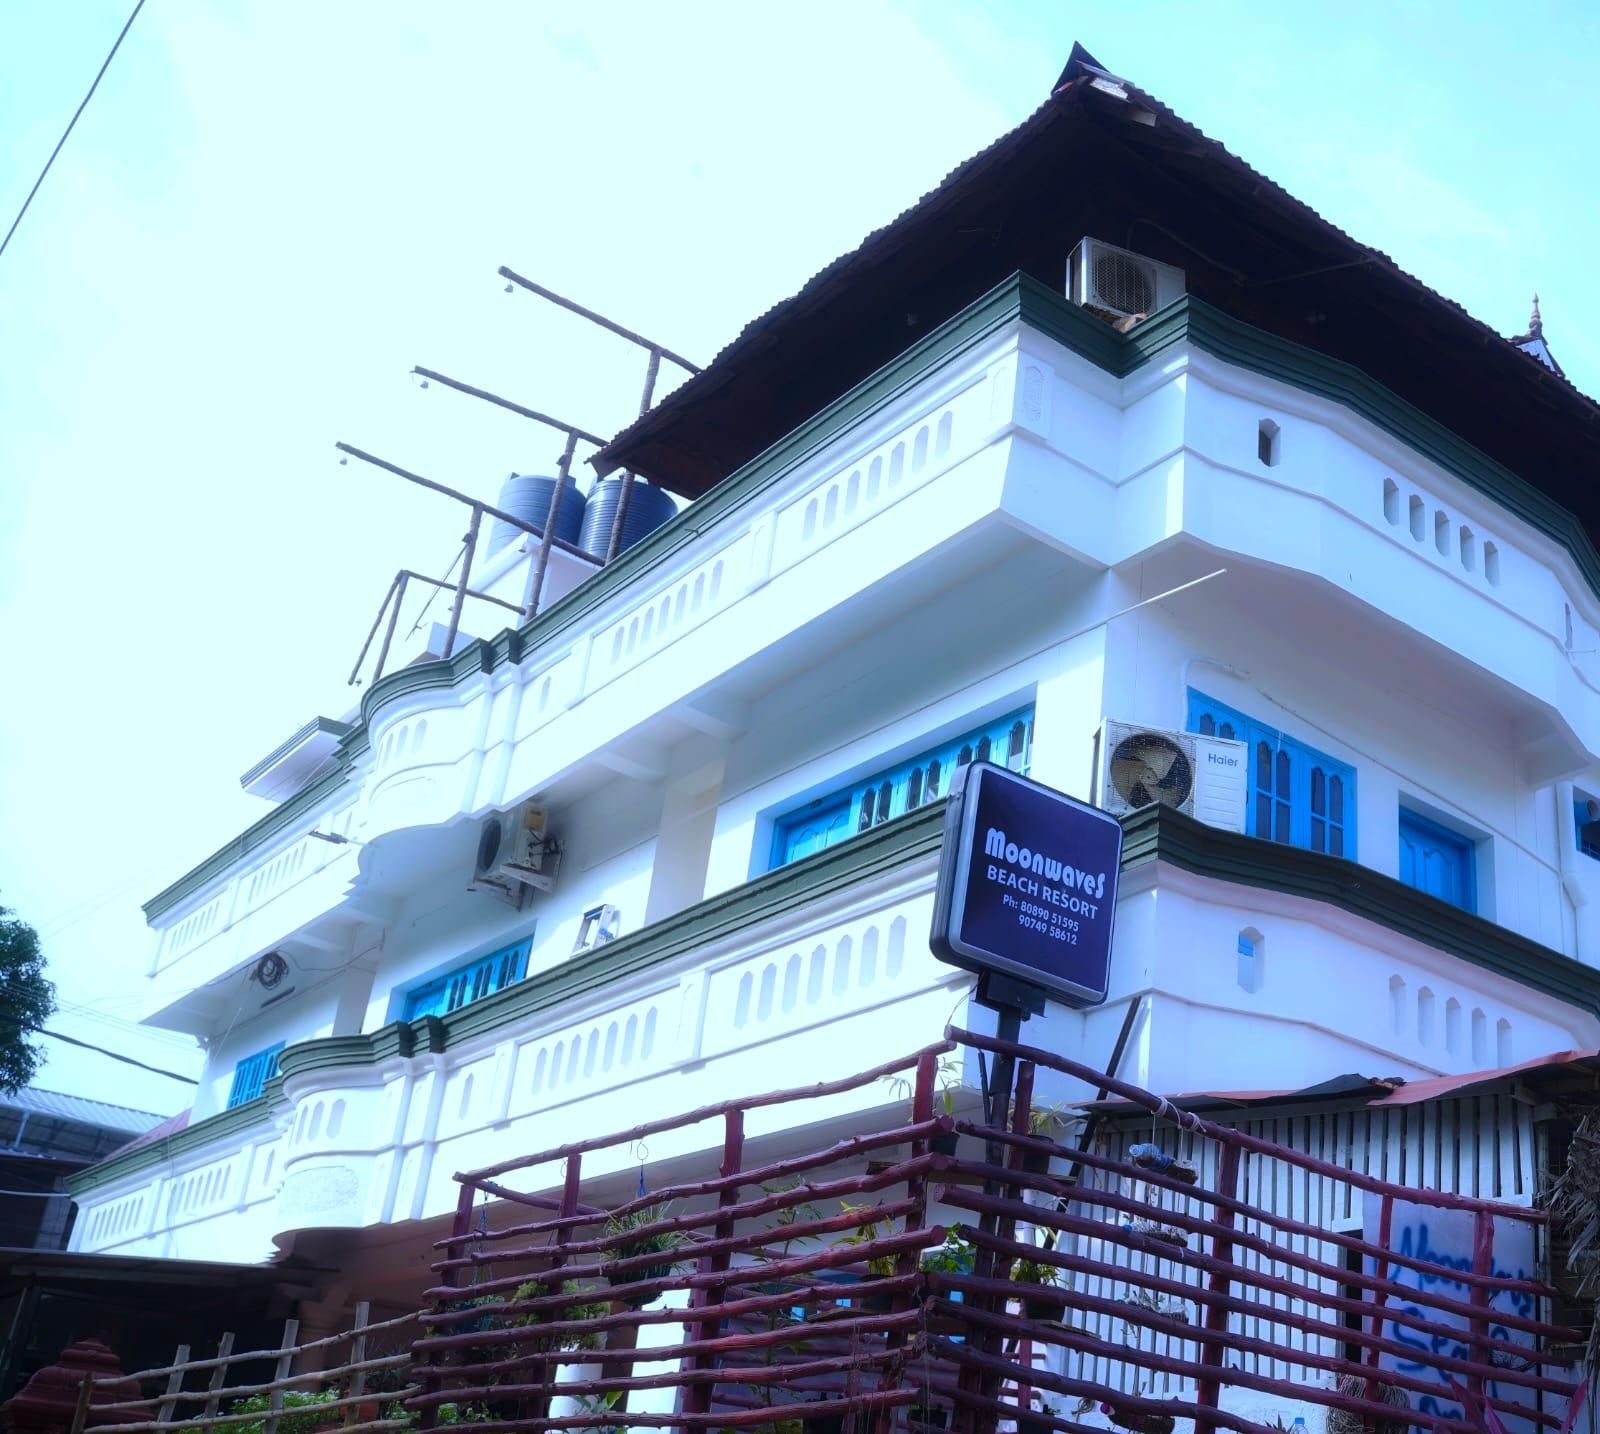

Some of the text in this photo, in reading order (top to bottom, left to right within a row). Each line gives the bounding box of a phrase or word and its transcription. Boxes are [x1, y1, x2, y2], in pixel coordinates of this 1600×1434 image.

[1208, 752, 1238, 767] Haier
[987, 864, 1099, 920] BEACH RESORT
[1002, 894, 1079, 932] Ph: 80890 51595
[1018, 914, 1078, 945] 90749 58612
